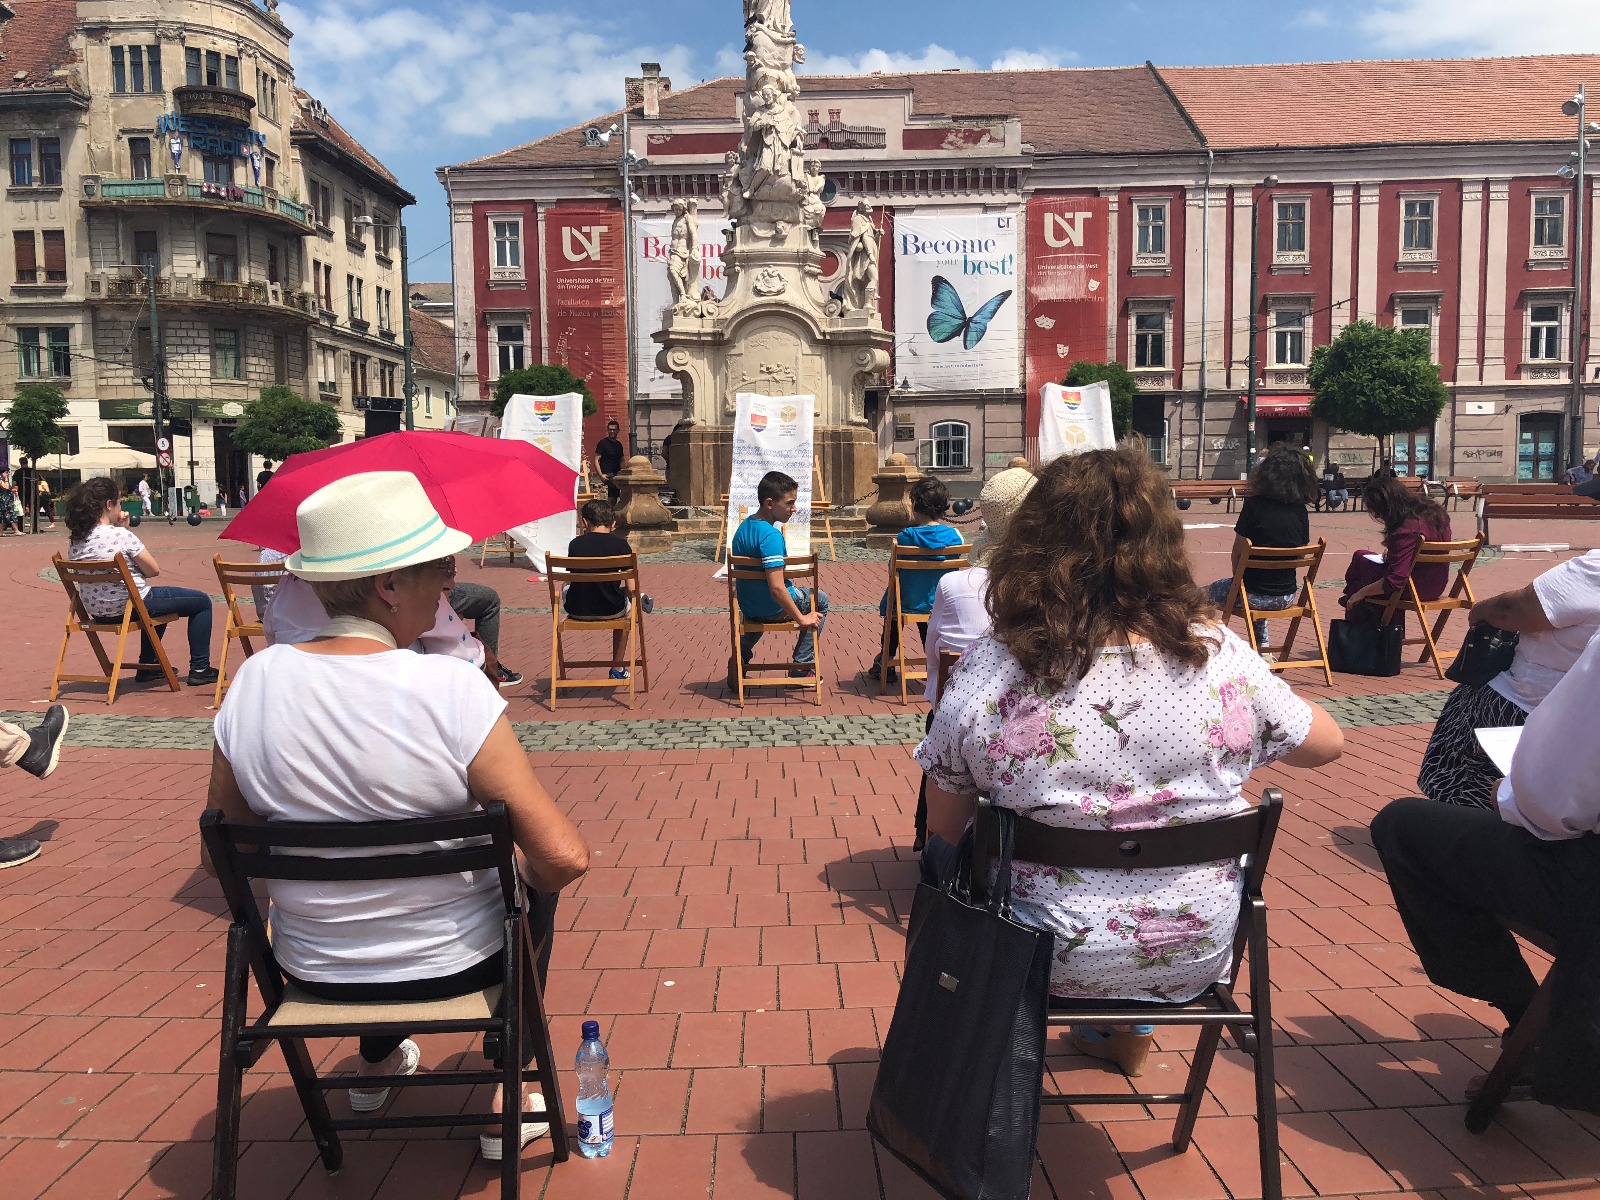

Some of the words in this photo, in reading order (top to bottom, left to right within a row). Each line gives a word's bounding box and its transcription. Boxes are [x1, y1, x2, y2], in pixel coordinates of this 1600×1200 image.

[157, 111, 221, 136] WEST
[901, 233, 996, 256] Become
[936, 258, 959, 268] your
[963, 253, 1014, 276] best!
